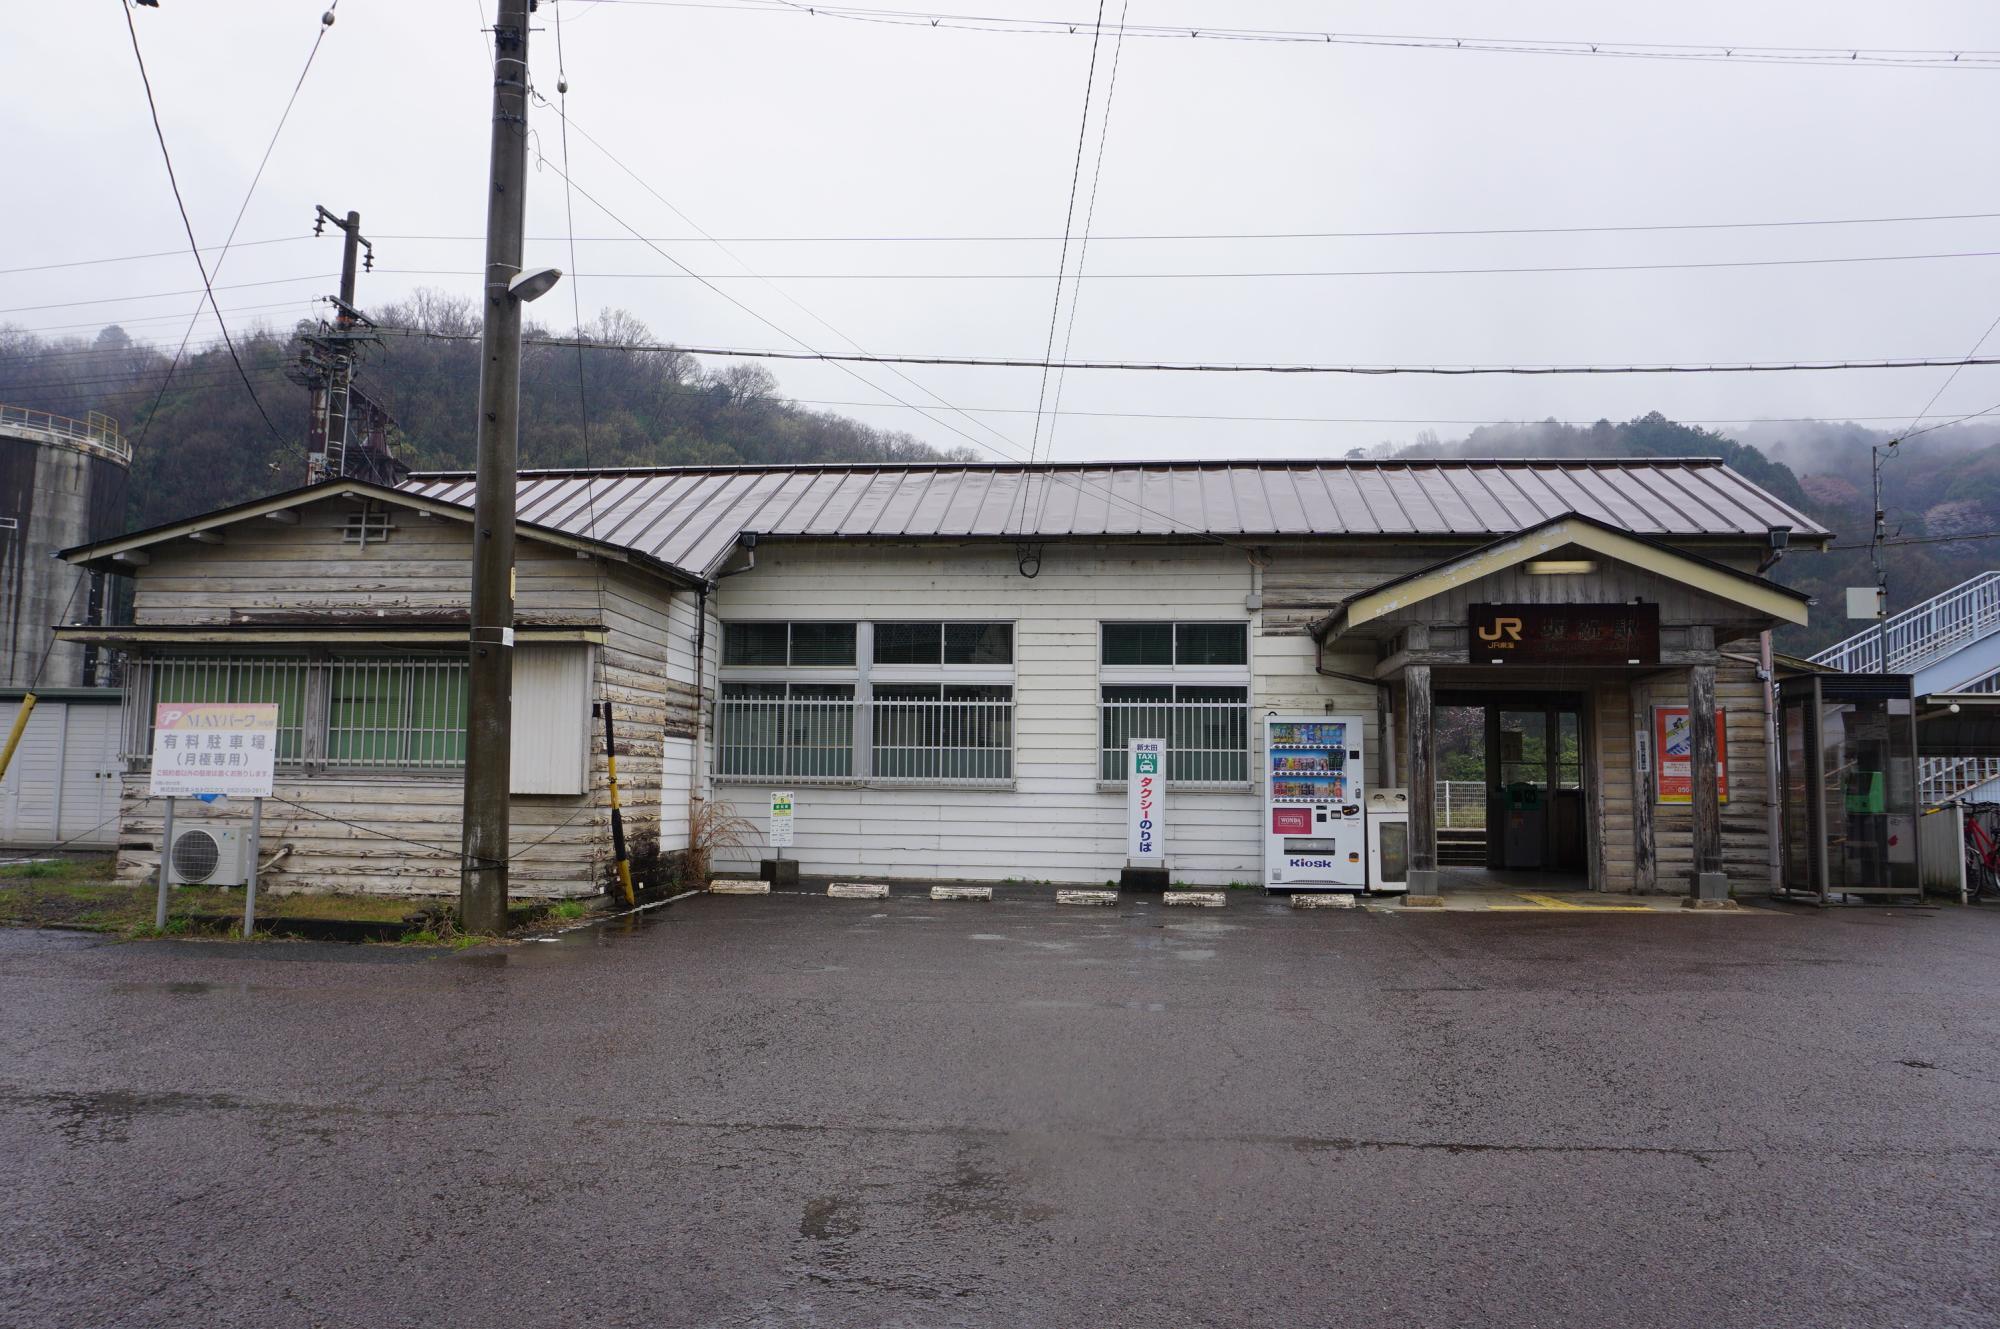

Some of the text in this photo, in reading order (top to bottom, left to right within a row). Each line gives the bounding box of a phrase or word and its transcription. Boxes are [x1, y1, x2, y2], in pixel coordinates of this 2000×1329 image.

[1478, 617, 1523, 641] JR
[164, 734, 266, 750] 有料駐車場
[1136, 744, 1158, 752] 新太田
[1139, 777, 1153, 853] タクシーのりば
[1289, 858, 1332, 868] Kiosk
